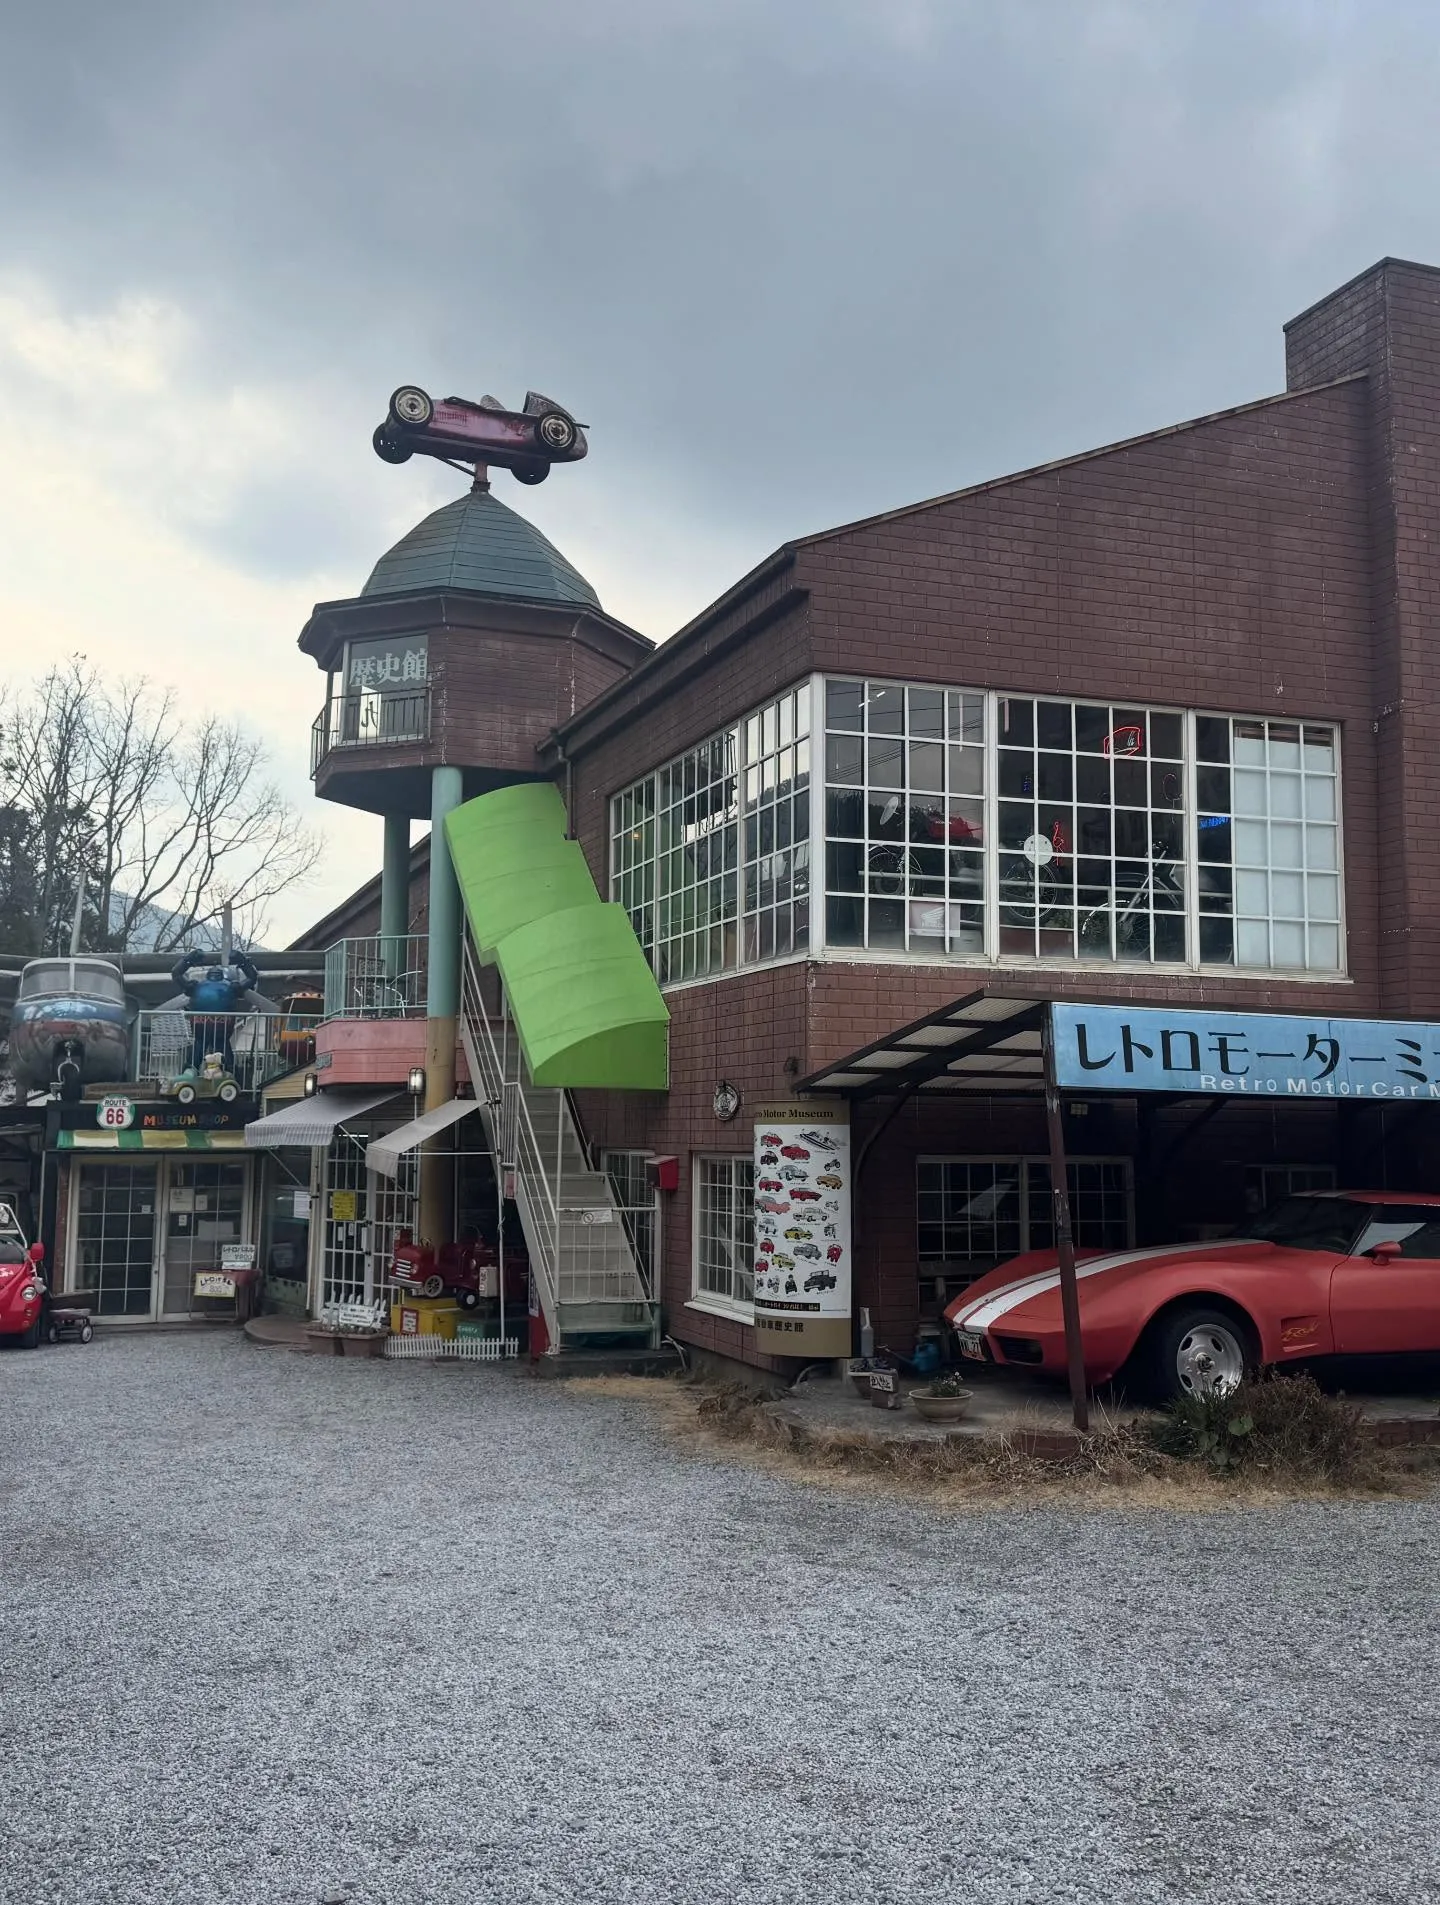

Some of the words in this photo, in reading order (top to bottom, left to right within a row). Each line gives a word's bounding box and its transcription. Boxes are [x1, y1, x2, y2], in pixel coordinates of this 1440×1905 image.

[350, 647, 428, 687] 歴史館
[1074, 1022, 1440, 1083] レトロモーターミ
[1200, 1075, 1278, 1092] Retro
[1287, 1077, 1364, 1095] Motor
[1371, 1081, 1419, 1096] Car
[106, 1108, 125, 1125] 66
[143, 1114, 197, 1126] MUSEUM
[763, 1109, 786, 1118] Motor
[788, 1108, 833, 1118] Museum
